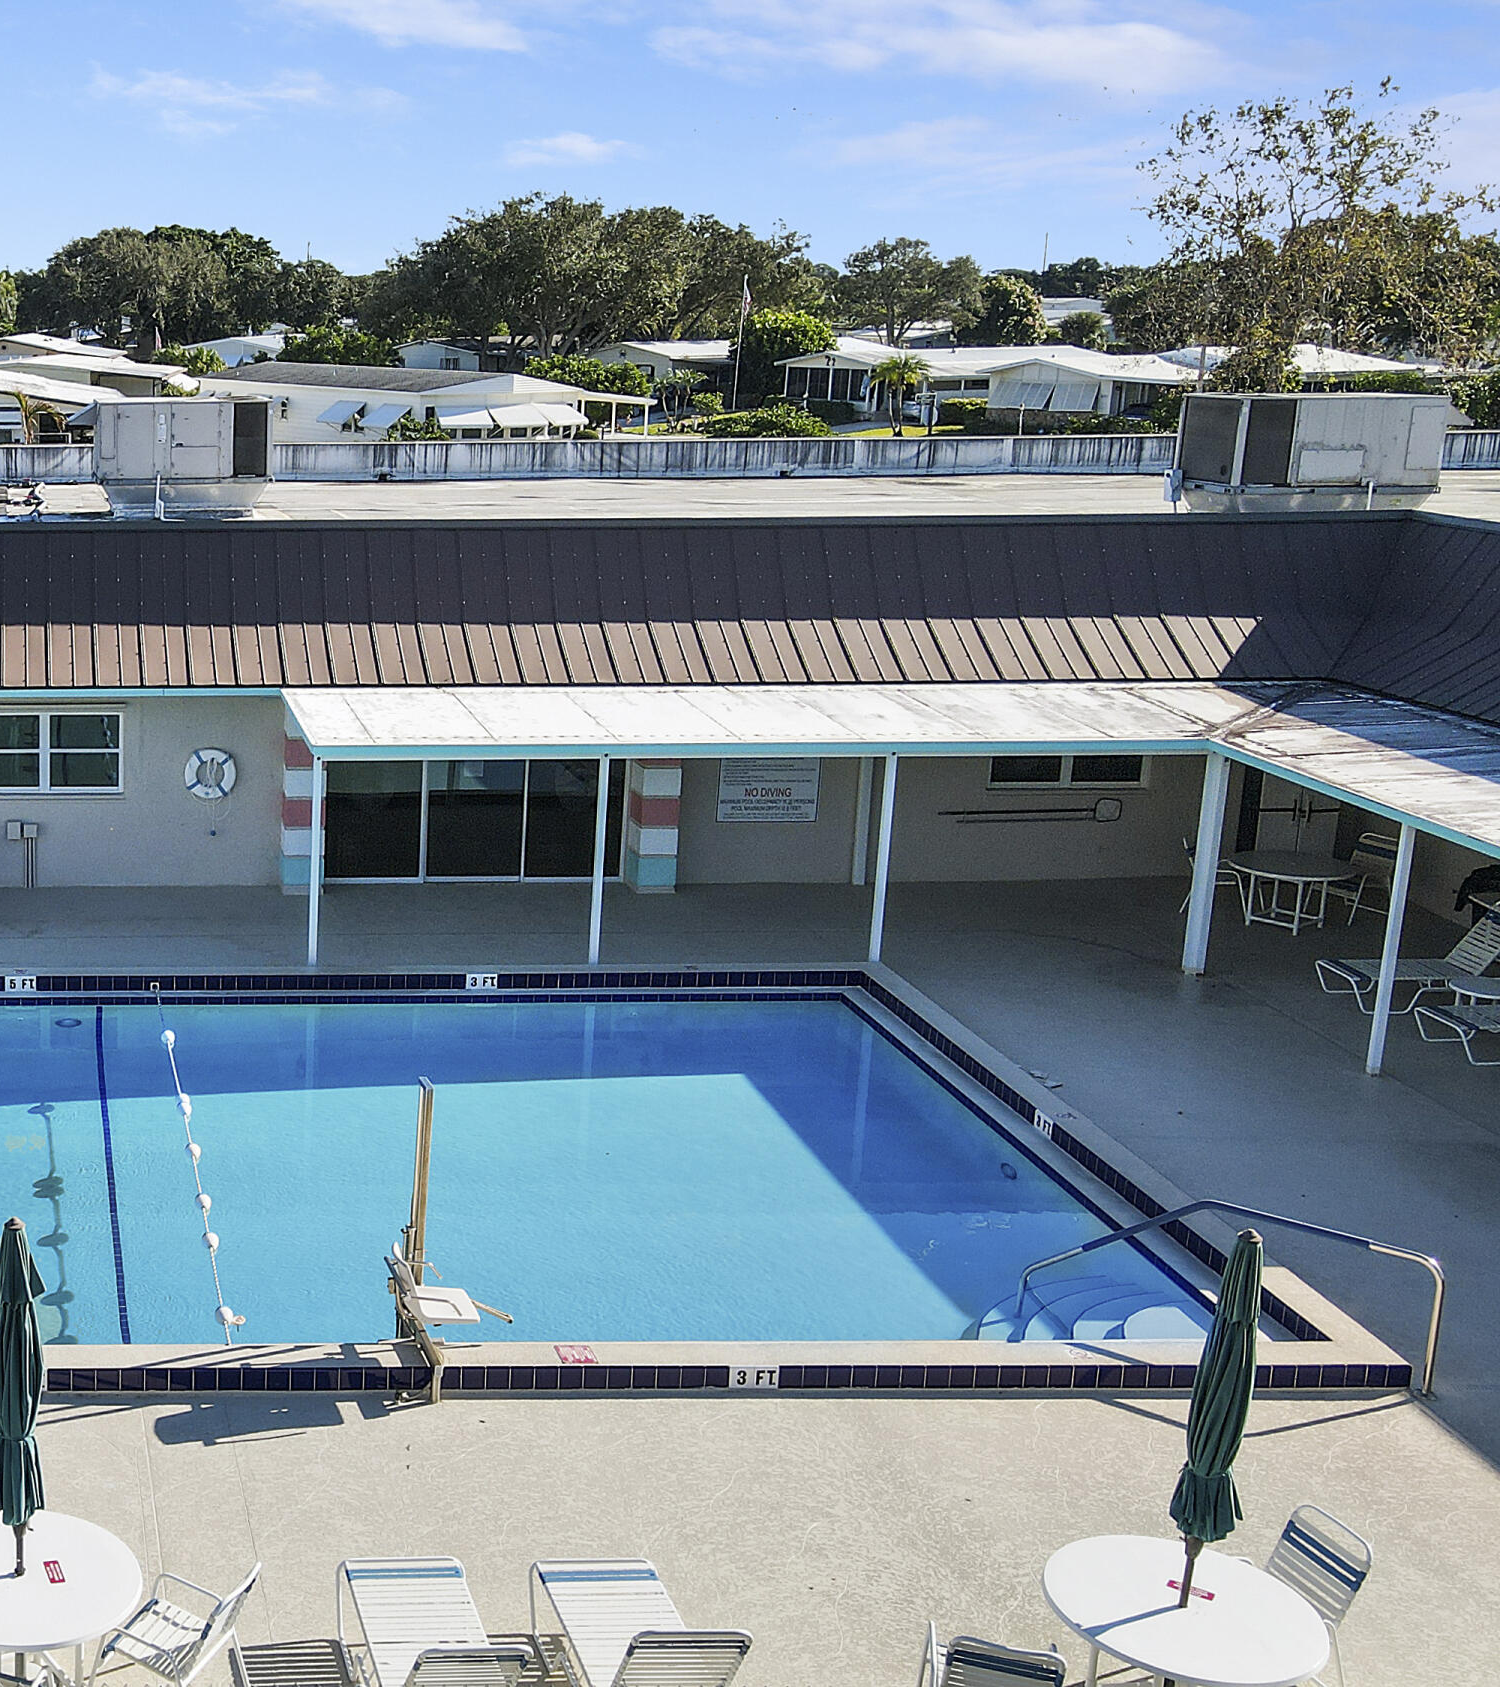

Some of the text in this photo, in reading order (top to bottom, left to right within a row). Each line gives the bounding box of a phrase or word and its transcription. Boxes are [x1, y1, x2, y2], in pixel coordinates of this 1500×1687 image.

[744, 787, 792, 797] NO DIVING
[9, 978, 16, 989] 5
[470, 976, 478, 987] 3
[736, 1370, 747, 1385] 3
